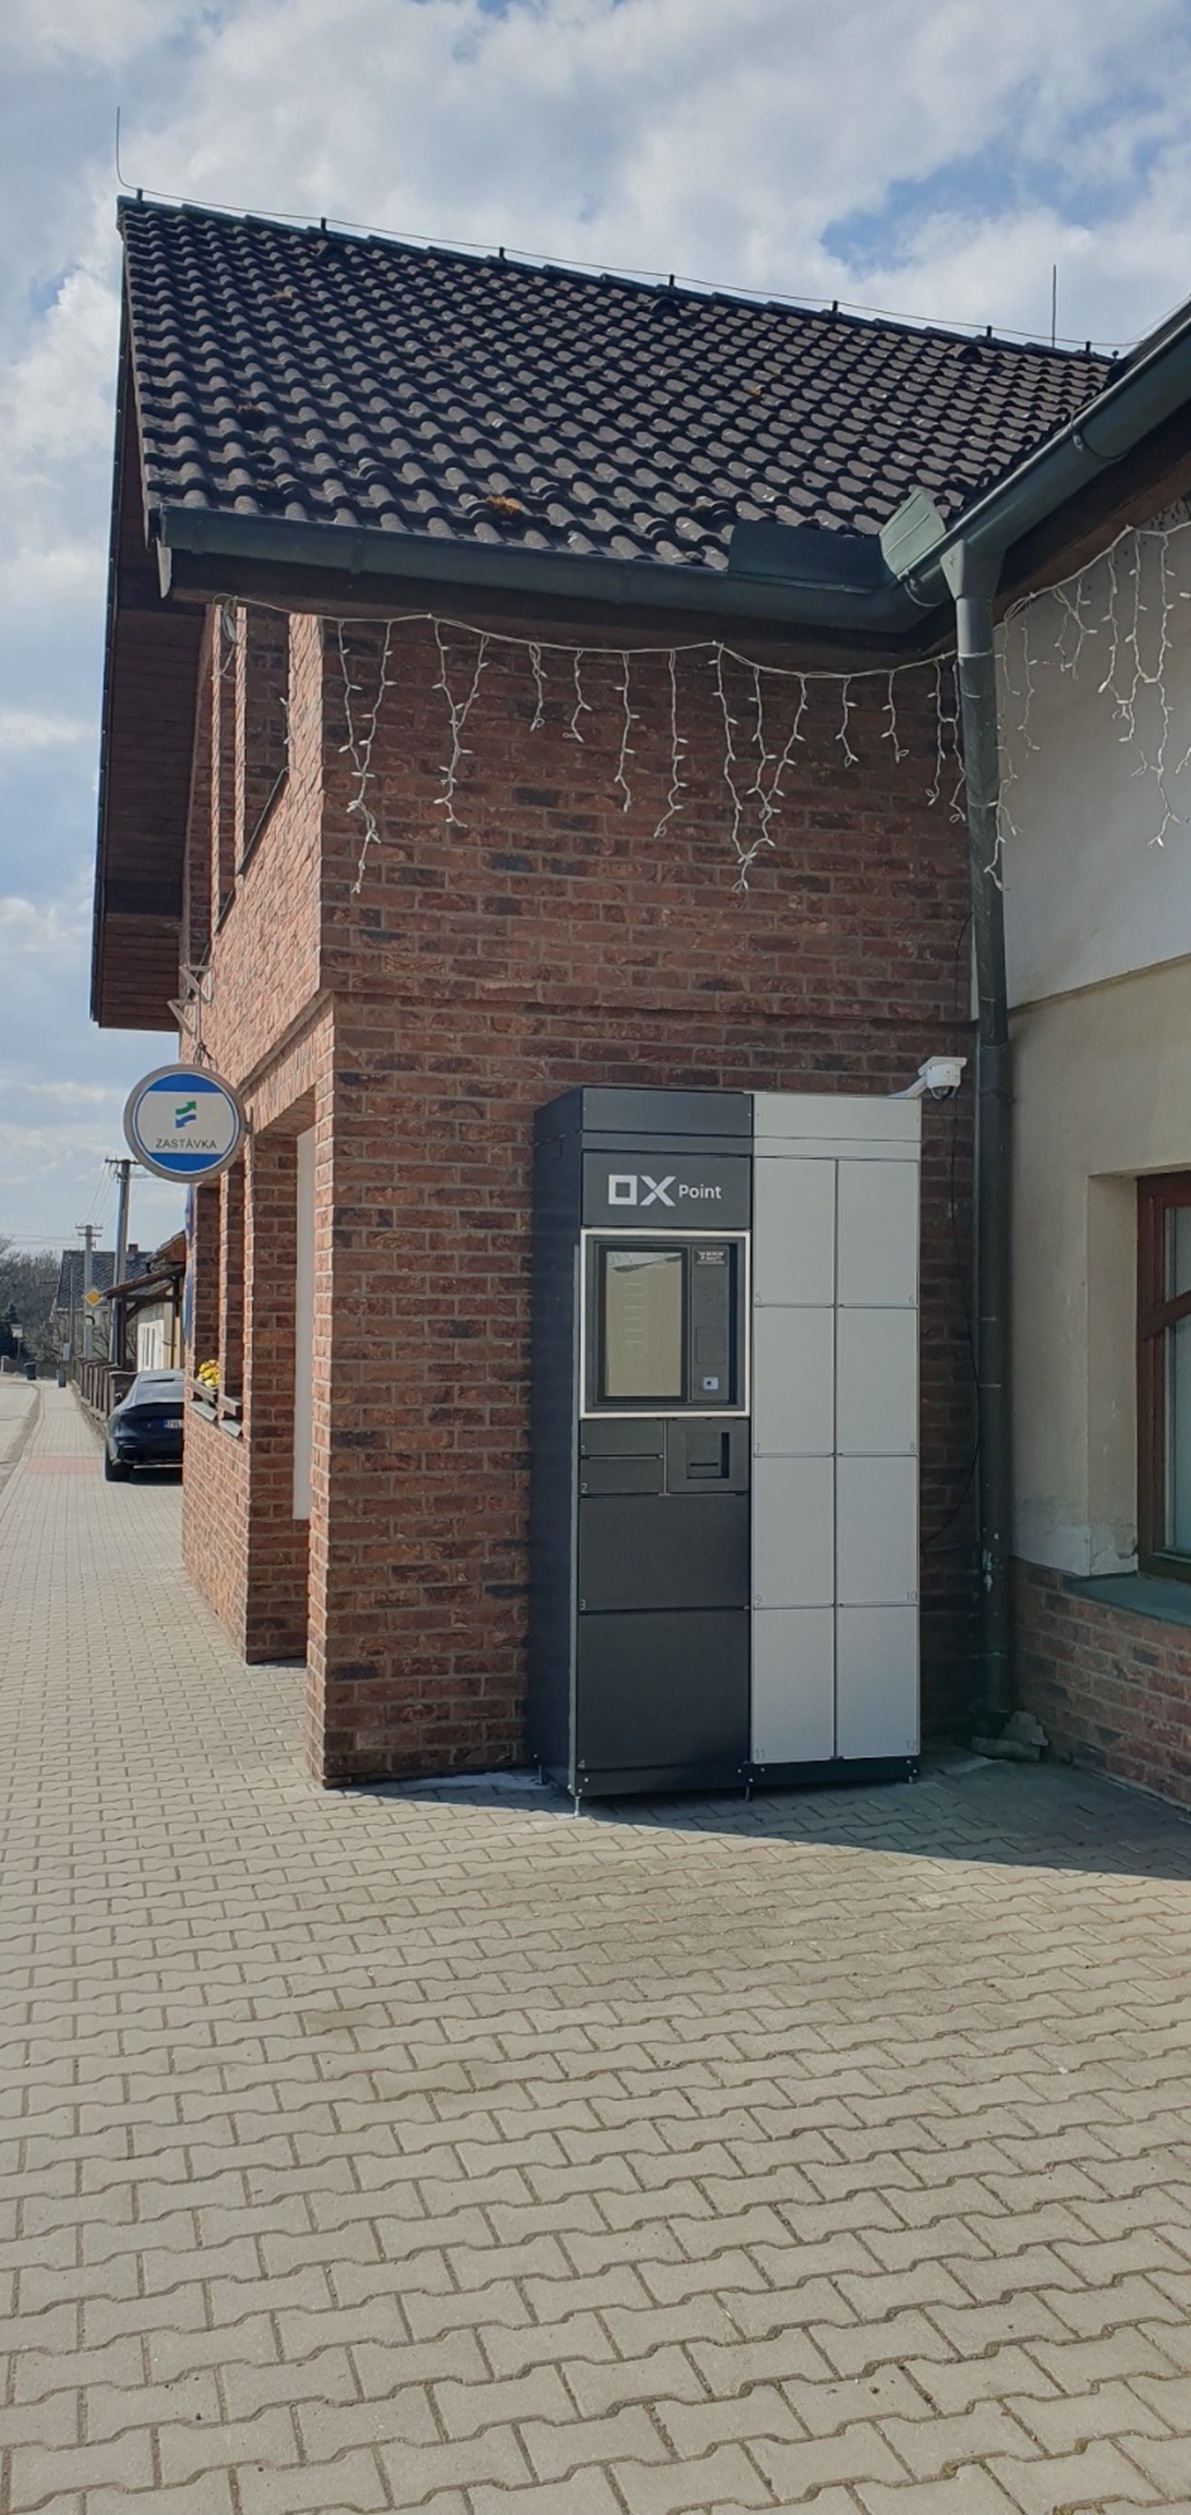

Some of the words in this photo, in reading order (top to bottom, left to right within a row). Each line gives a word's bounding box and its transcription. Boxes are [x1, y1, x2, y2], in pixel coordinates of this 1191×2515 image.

[155, 1137, 218, 1149] ZASTÁVKA
[679, 1184, 722, 1199] Point
[755, 1293, 762, 1304] 5
[755, 1442, 761, 1452] 7
[581, 1482, 588, 1494] 2
[580, 1599, 587, 1611] 3
[755, 1594, 762, 1605] 9
[577, 1759, 585, 1769] 4
